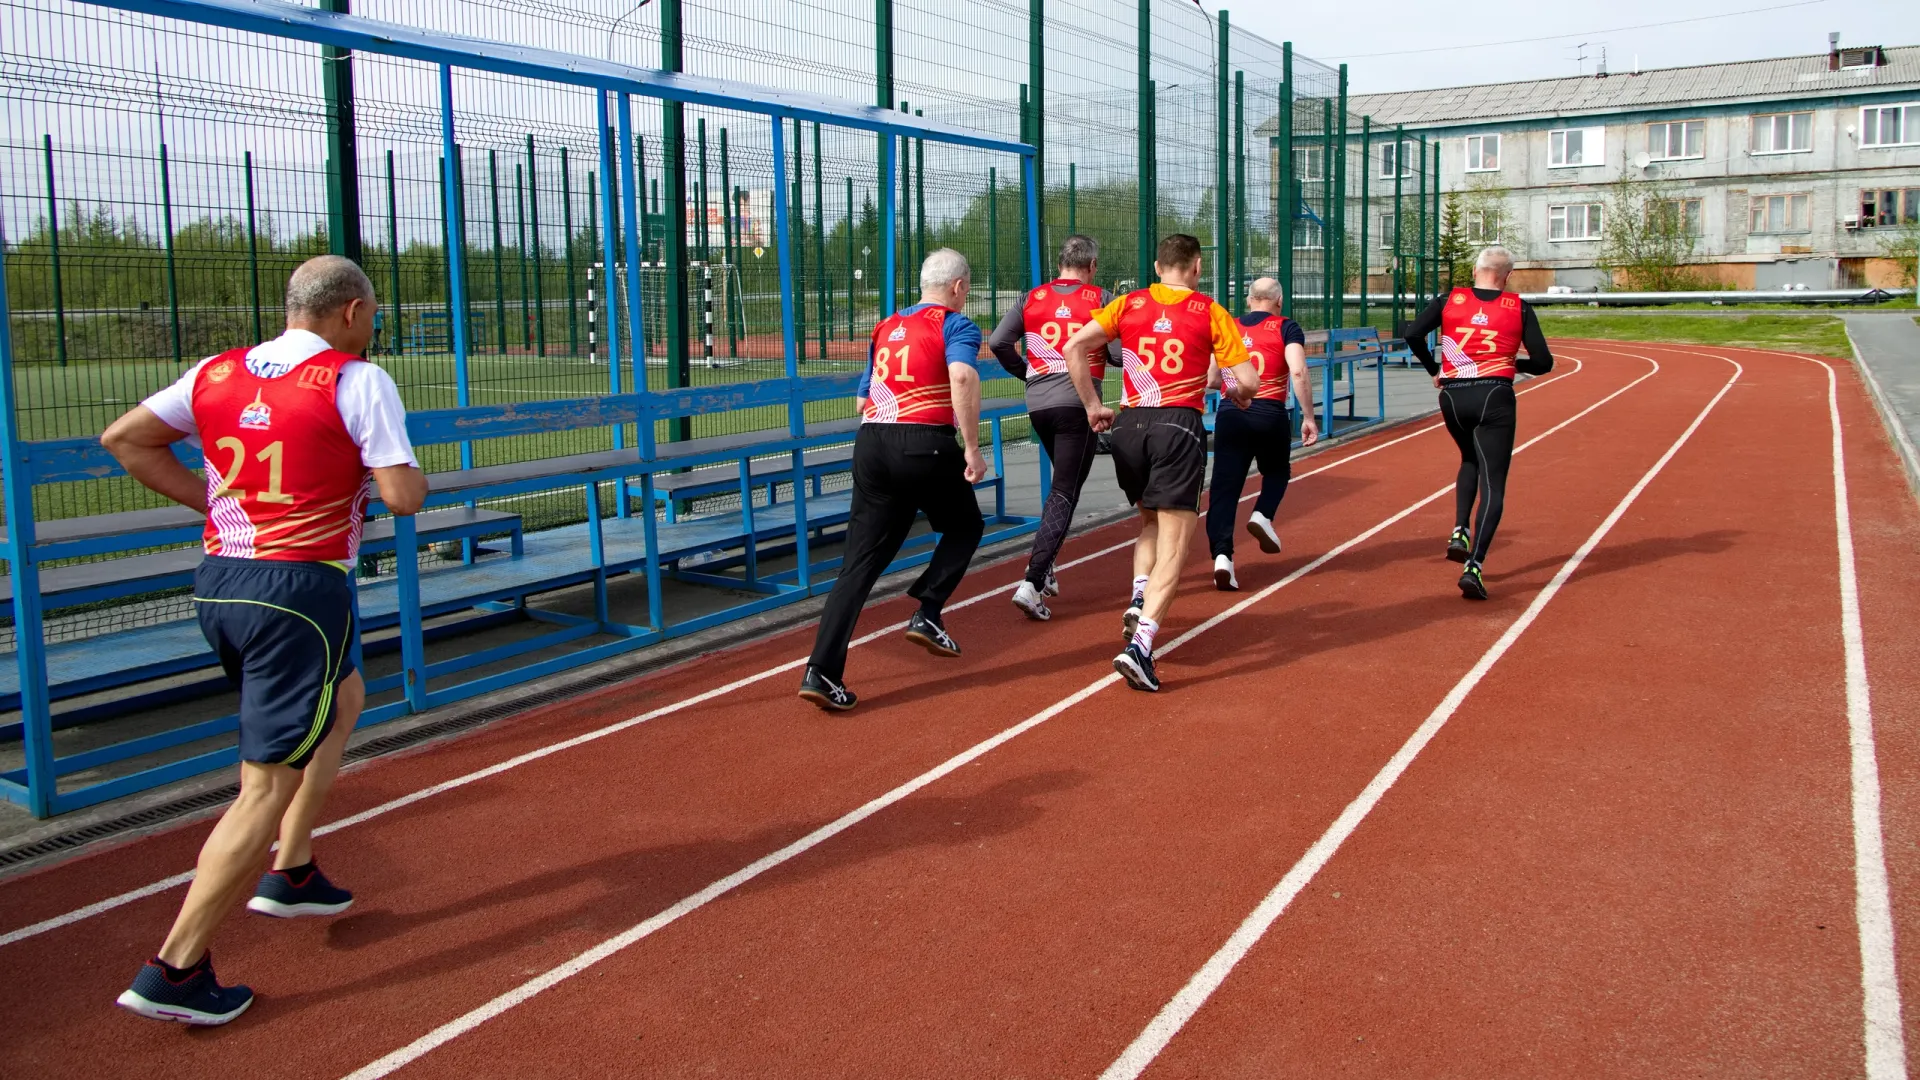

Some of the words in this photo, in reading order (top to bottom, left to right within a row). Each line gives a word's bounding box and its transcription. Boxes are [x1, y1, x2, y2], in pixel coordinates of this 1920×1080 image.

[1136, 337, 1184, 374] 58
[1455, 326, 1498, 354] 73
[874, 345, 914, 383] 81
[215, 436, 294, 505] 21
